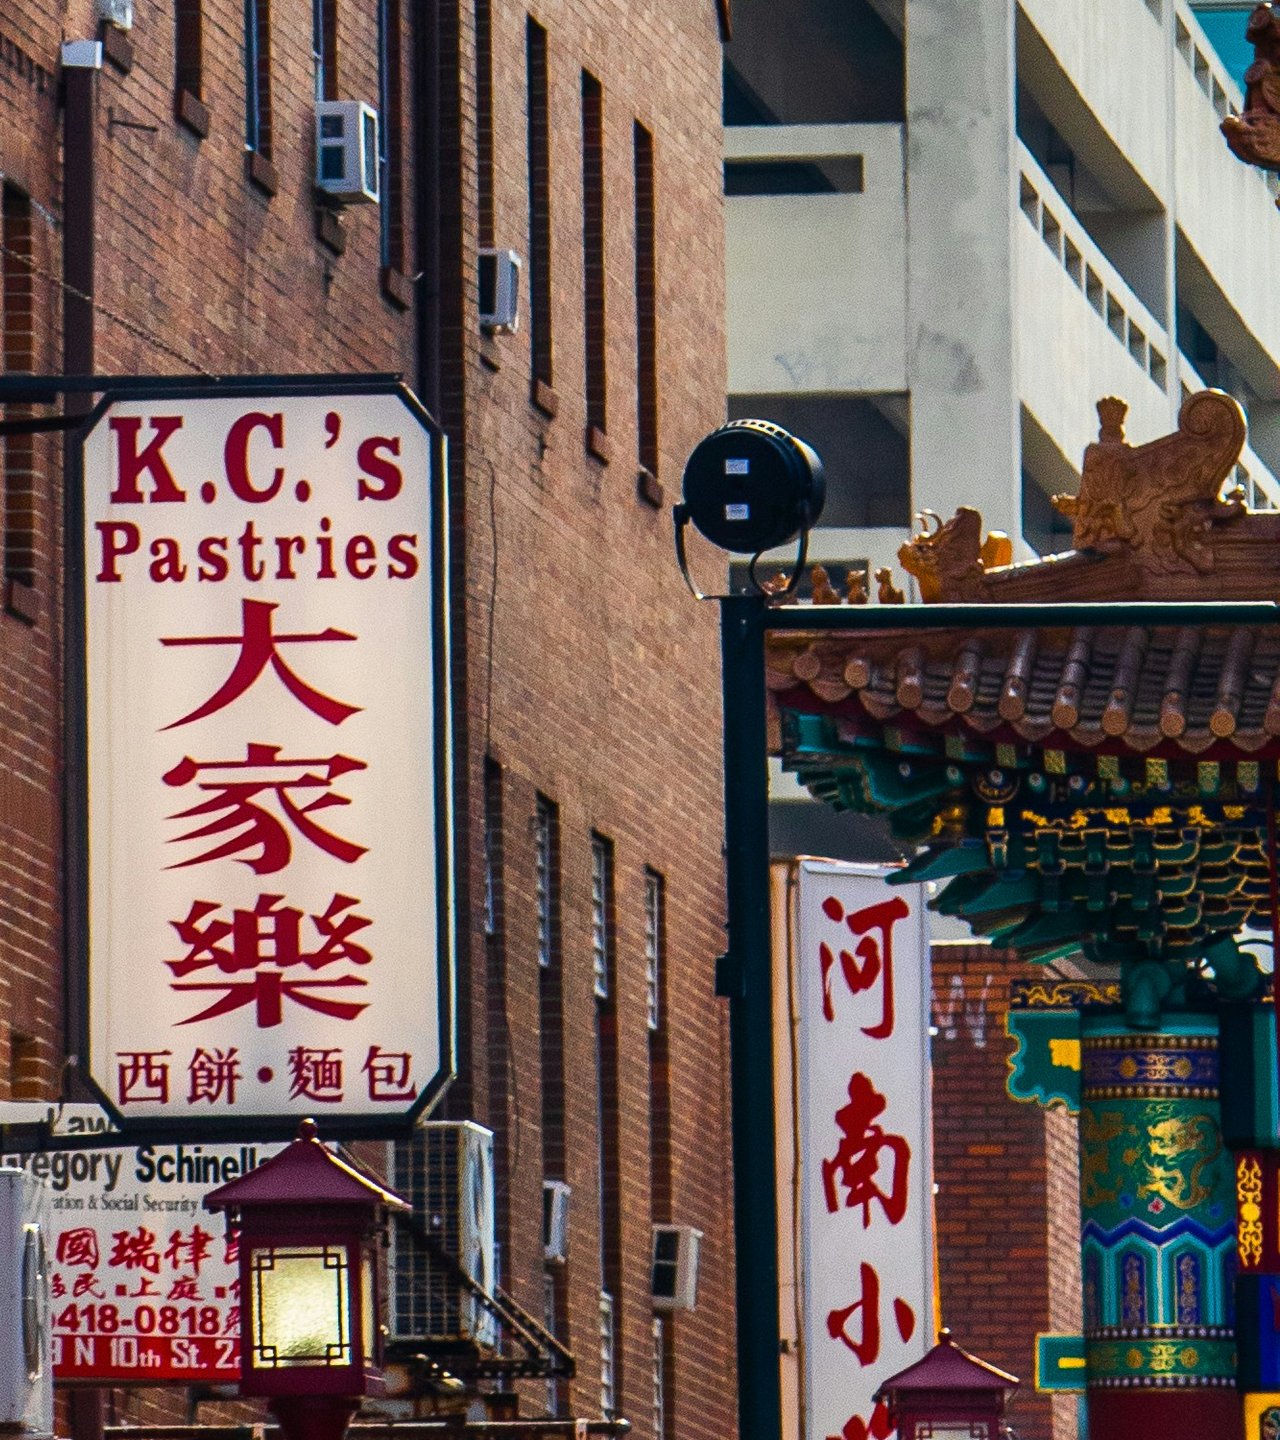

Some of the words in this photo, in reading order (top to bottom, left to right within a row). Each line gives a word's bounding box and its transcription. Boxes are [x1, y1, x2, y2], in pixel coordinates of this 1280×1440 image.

[108, 411, 407, 505] K.C.'s
[95, 516, 420, 584] Pastries
[156, 597, 374, 1029] 大家樂
[135, 1144, 270, 1184] Schinell
[101, 1193, 139, 1212] Social
[143, 1192, 199, 1218] Security
[52, 1302, 221, 1336] 418-0818
[74, 1337, 96, 1367] N
[110, 1336, 161, 1368] 10th
[170, 1335, 208, 1369] St.
